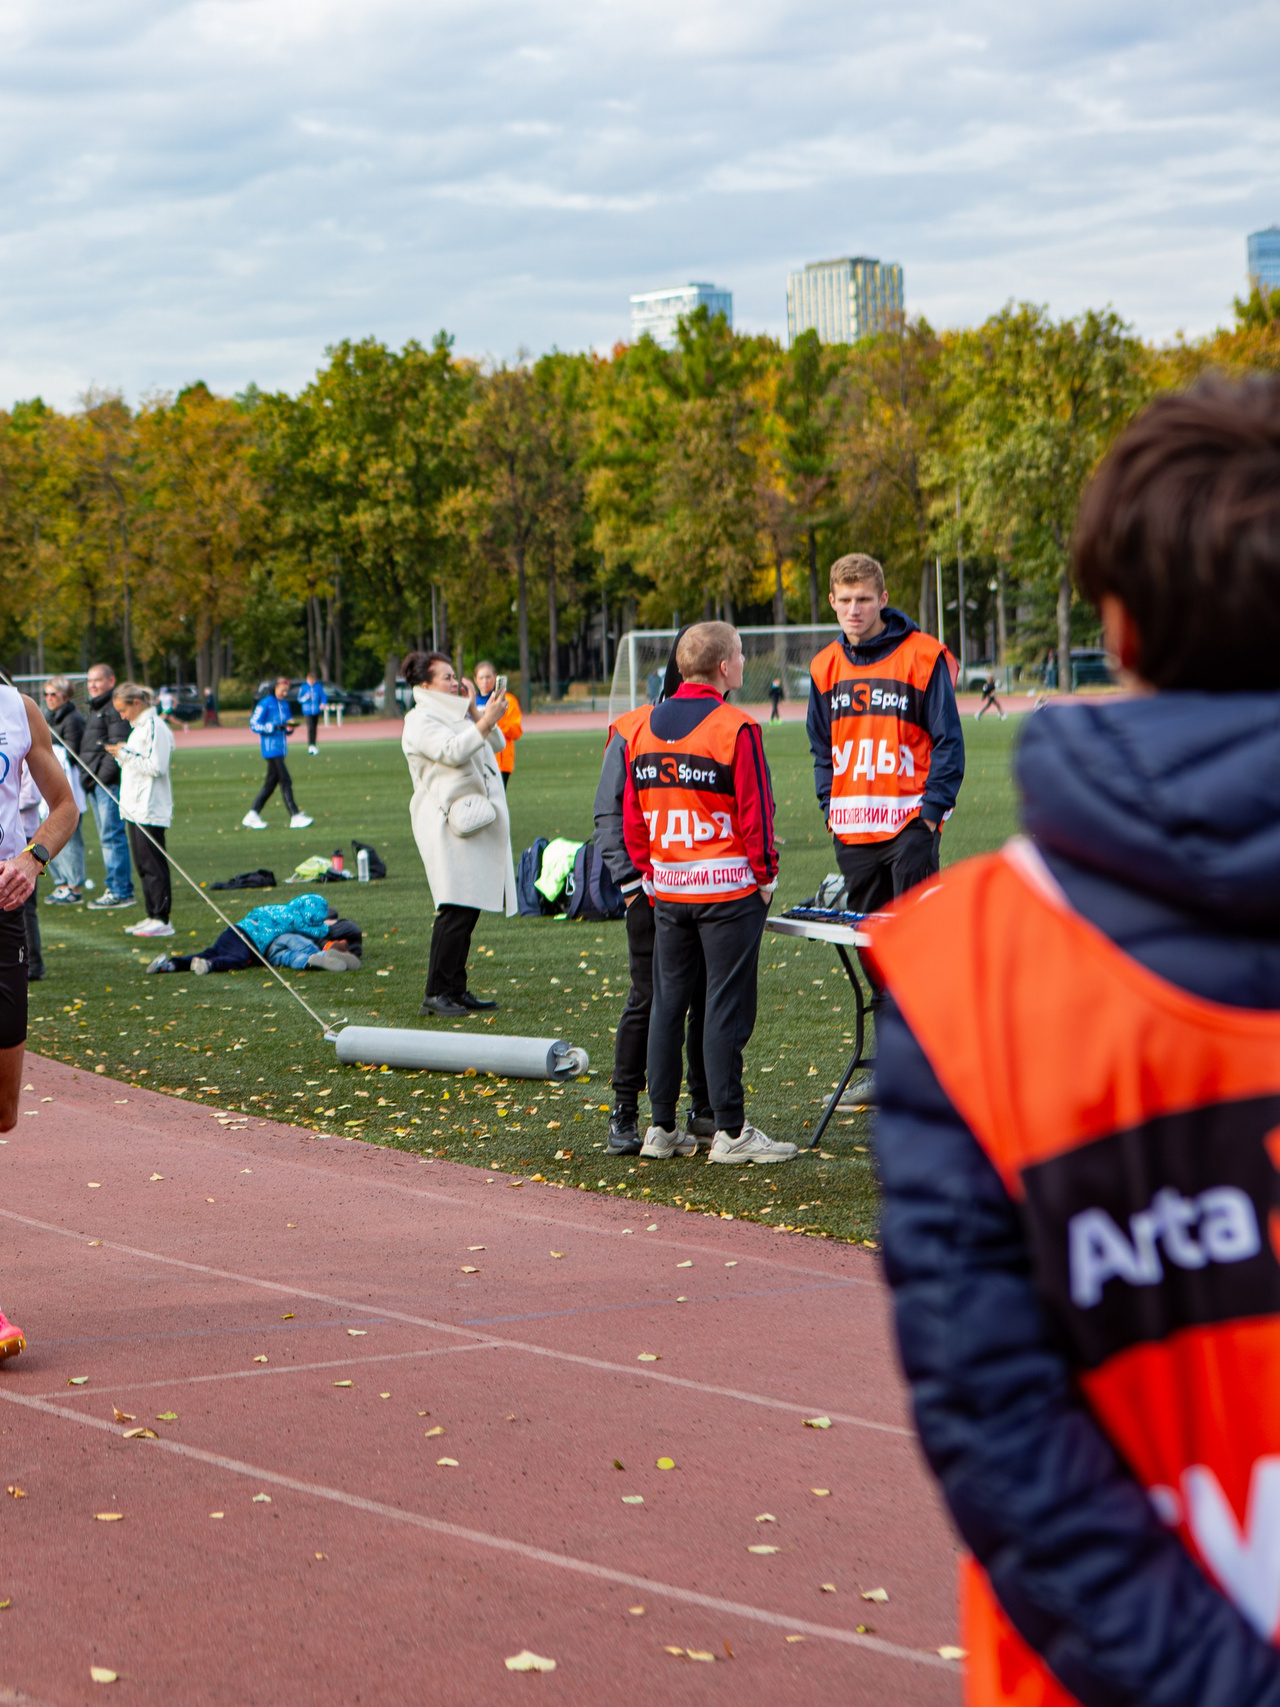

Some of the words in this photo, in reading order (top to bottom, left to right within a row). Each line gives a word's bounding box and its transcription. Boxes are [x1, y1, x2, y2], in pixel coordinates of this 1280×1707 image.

[871, 688, 909, 711] Sport
[678, 763, 717, 784] Sport
[831, 738, 915, 781] УДЬЯ
[643, 809, 735, 849] УДЬЯ
[713, 866, 749, 885] СПОРТ
[1067, 1187, 1261, 1308] Arta
